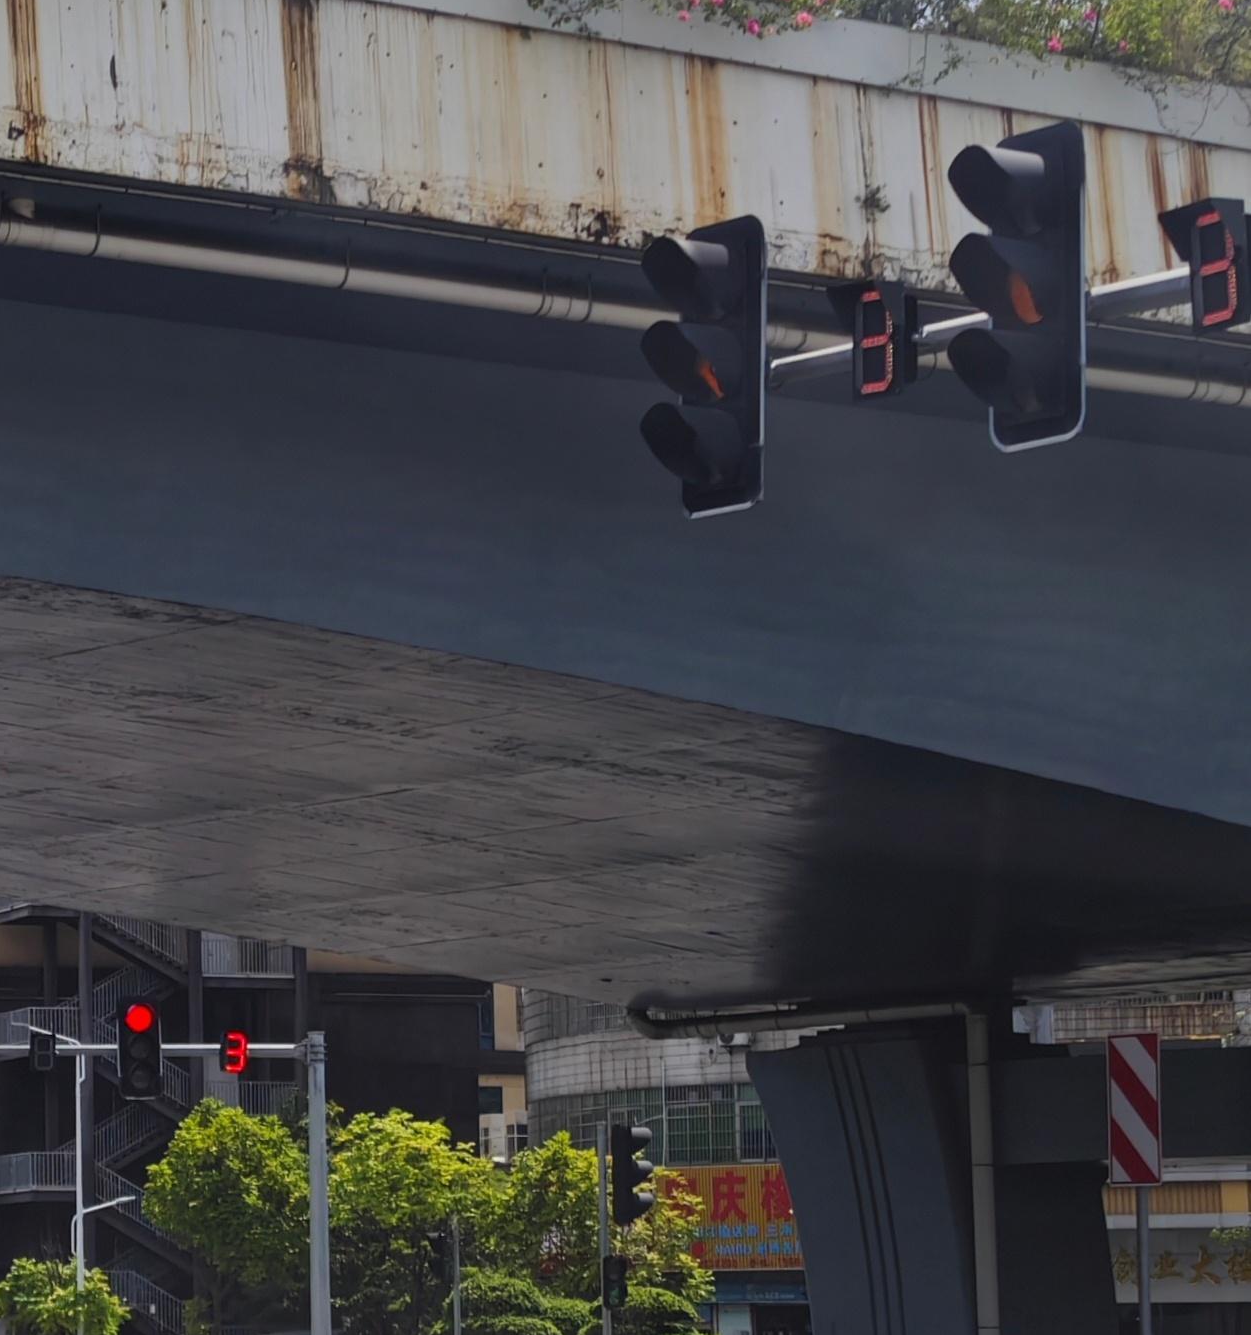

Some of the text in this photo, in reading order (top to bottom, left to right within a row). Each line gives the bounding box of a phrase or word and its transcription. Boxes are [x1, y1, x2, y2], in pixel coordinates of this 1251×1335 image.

[1196, 211, 1237, 327] 3
[860, 290, 893, 395] 3
[225, 1031, 248, 1073] 3
